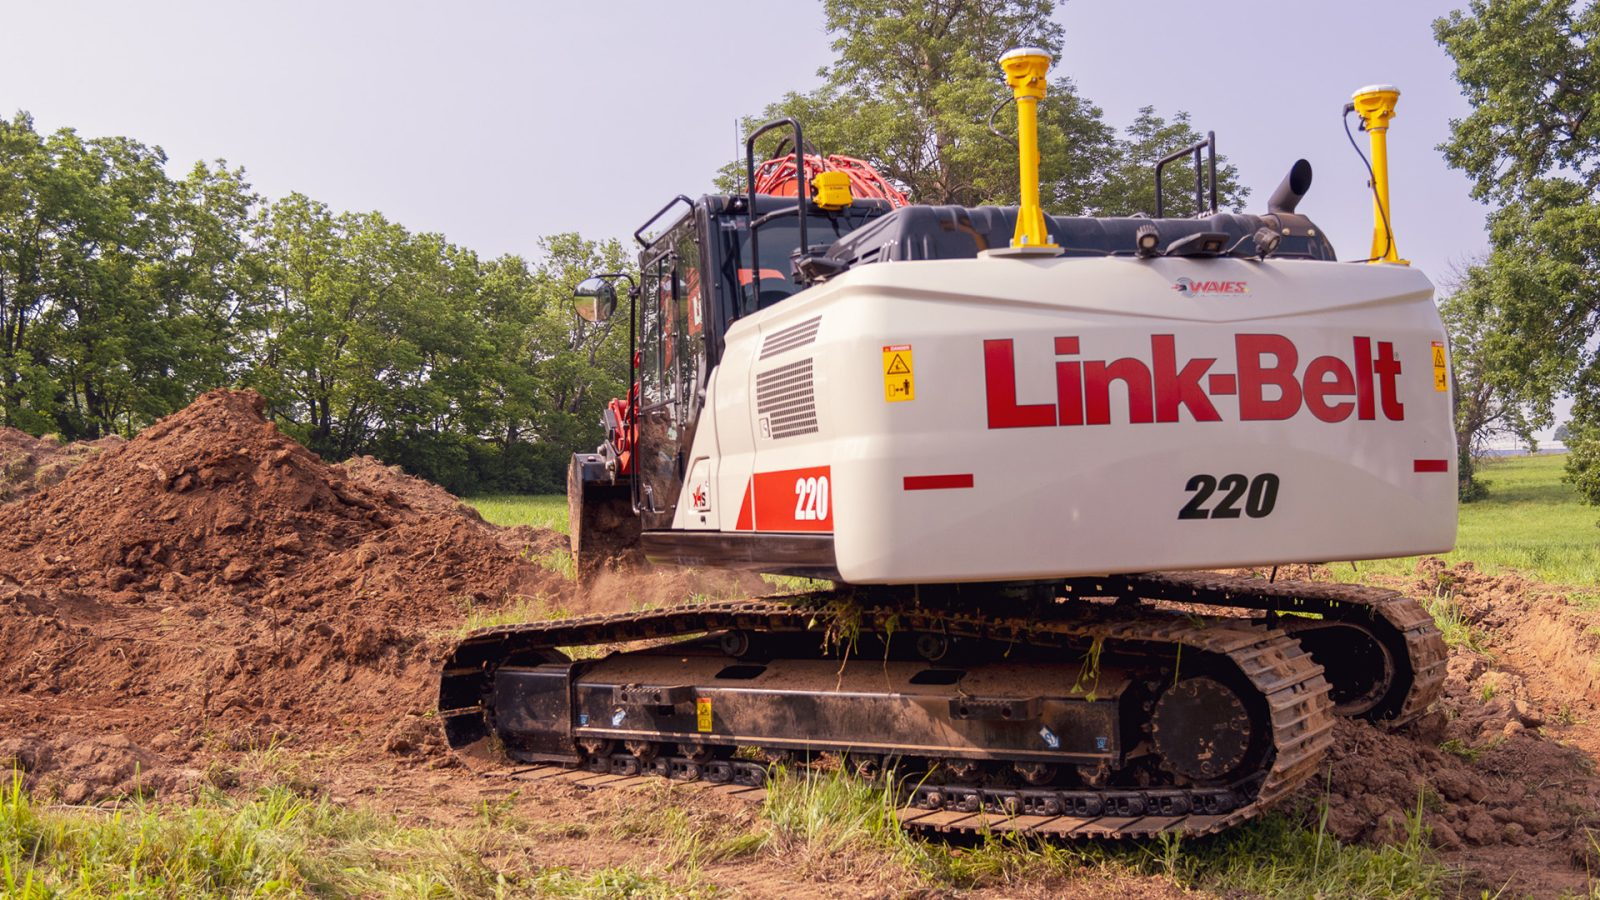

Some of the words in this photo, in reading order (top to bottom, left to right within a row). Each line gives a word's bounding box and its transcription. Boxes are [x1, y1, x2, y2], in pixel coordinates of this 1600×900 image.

[1189, 280, 1247, 293] WAVES
[984, 333, 1405, 429] Link-Belt
[795, 476, 828, 520] 220
[1178, 473, 1279, 519] 220
